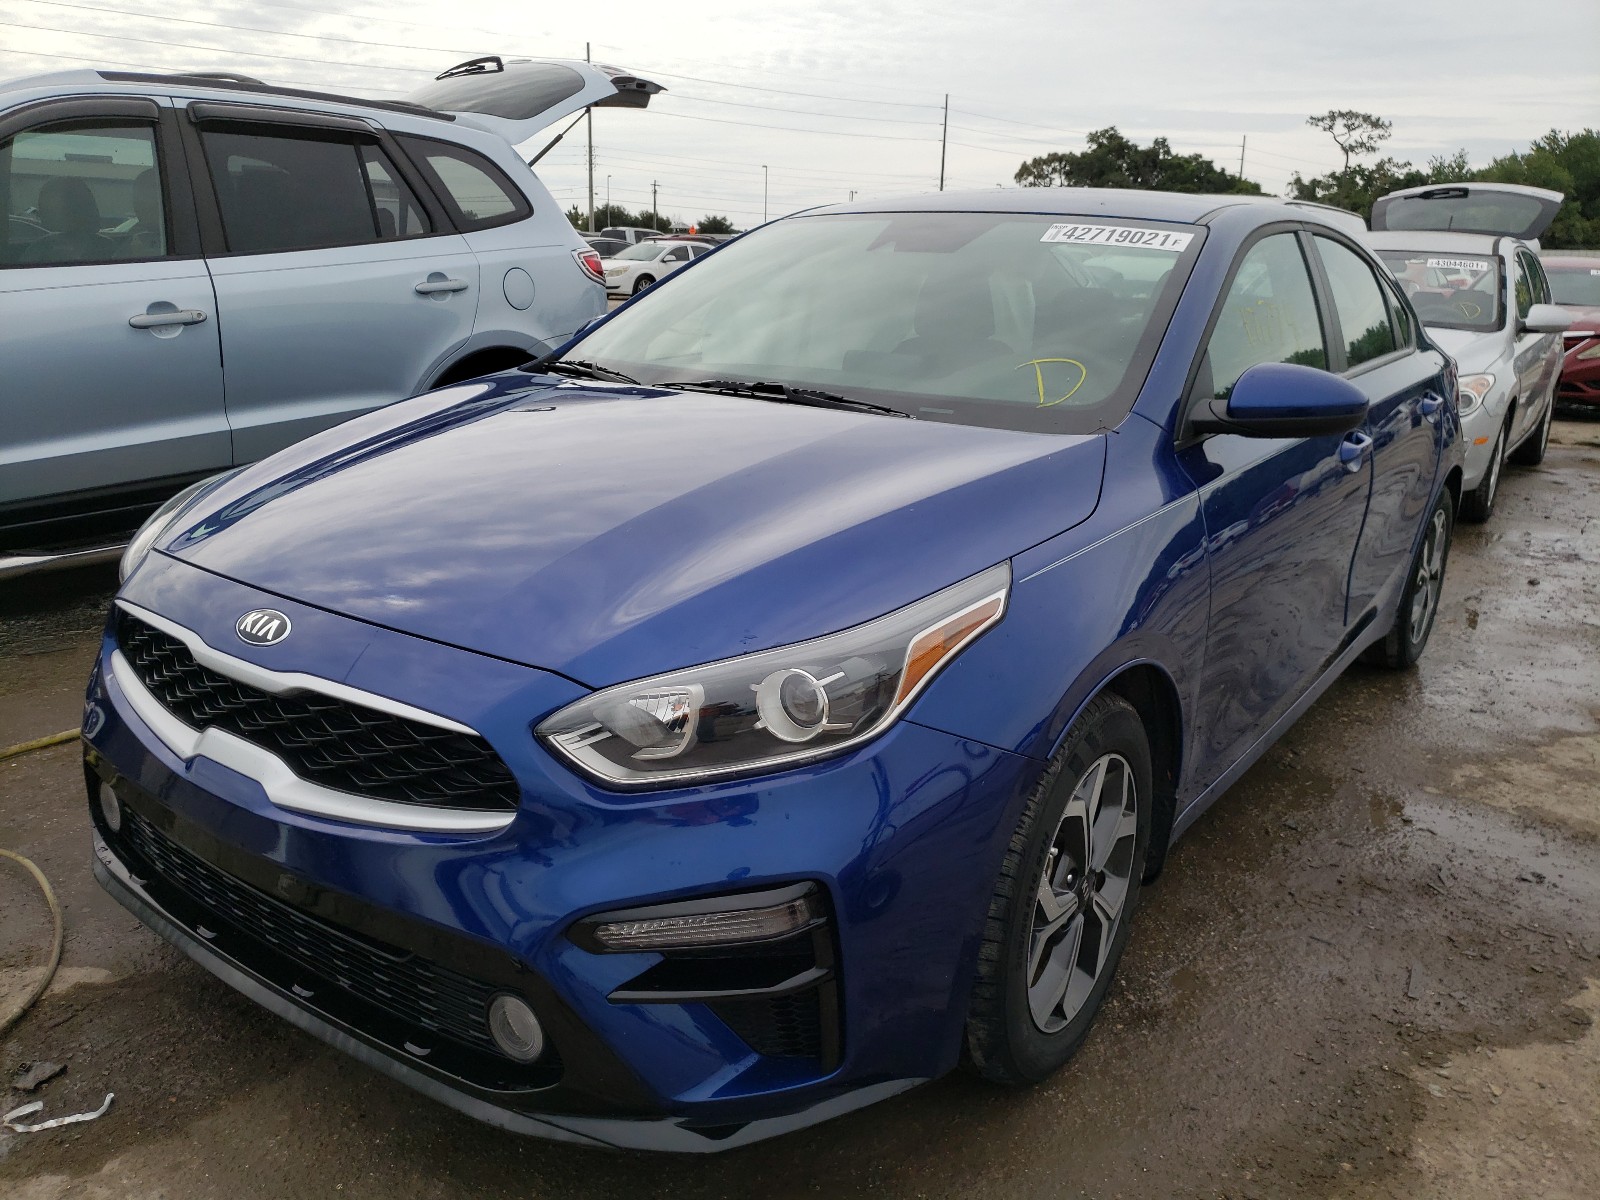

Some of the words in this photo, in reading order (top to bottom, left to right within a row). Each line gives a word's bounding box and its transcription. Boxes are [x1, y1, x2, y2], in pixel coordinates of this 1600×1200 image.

[1061, 225, 1172, 247] 42719021
[1171, 238, 1183, 247] F
[1014, 357, 1087, 409] D
[239, 611, 282, 641] KIA
